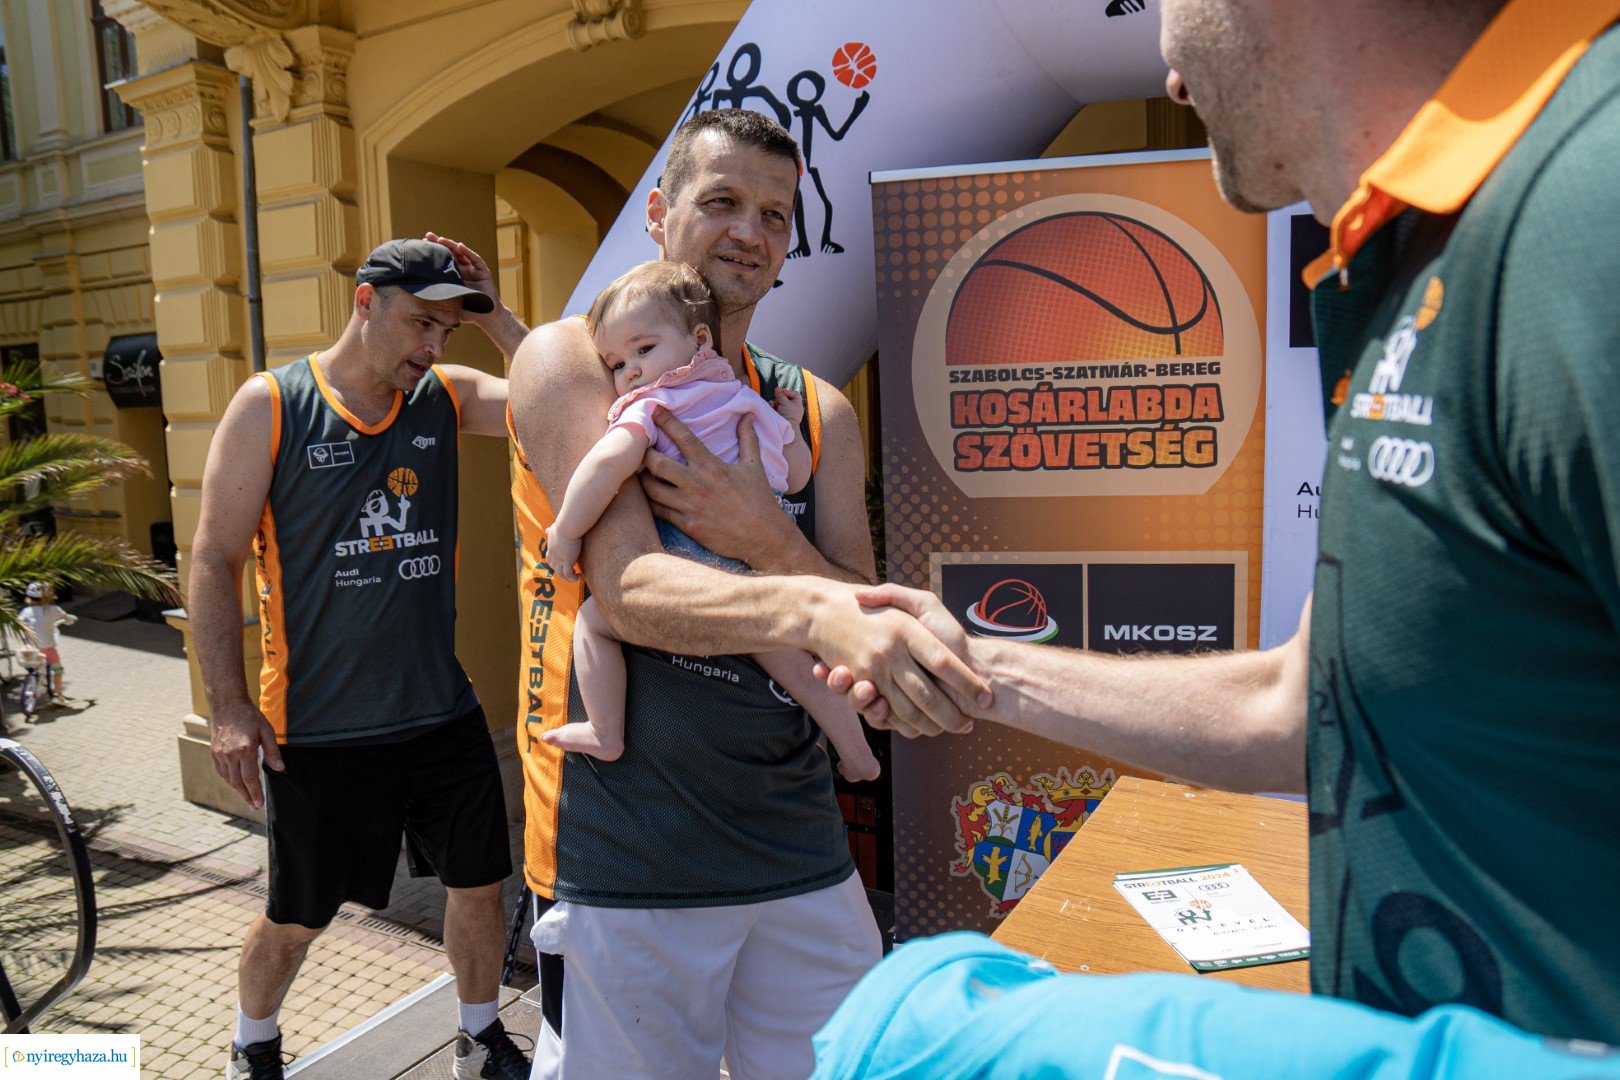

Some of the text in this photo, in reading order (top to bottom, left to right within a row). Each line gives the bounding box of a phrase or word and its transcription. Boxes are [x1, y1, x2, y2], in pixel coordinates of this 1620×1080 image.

[949, 361, 1221, 383] SZABOLCS-SZATMÁR-BEREG
[951, 382, 1224, 428] KOSÁRLABDA
[953, 421, 1218, 471] SZÖVETSÉG
[334, 529, 438, 556] STREETBALL
[334, 568, 359, 578] Audi
[335, 576, 381, 587] Hungaria
[1103, 624, 1217, 642] MKOSZ
[671, 655, 740, 682] Hungaria
[1200, 872, 1231, 881] 2024
